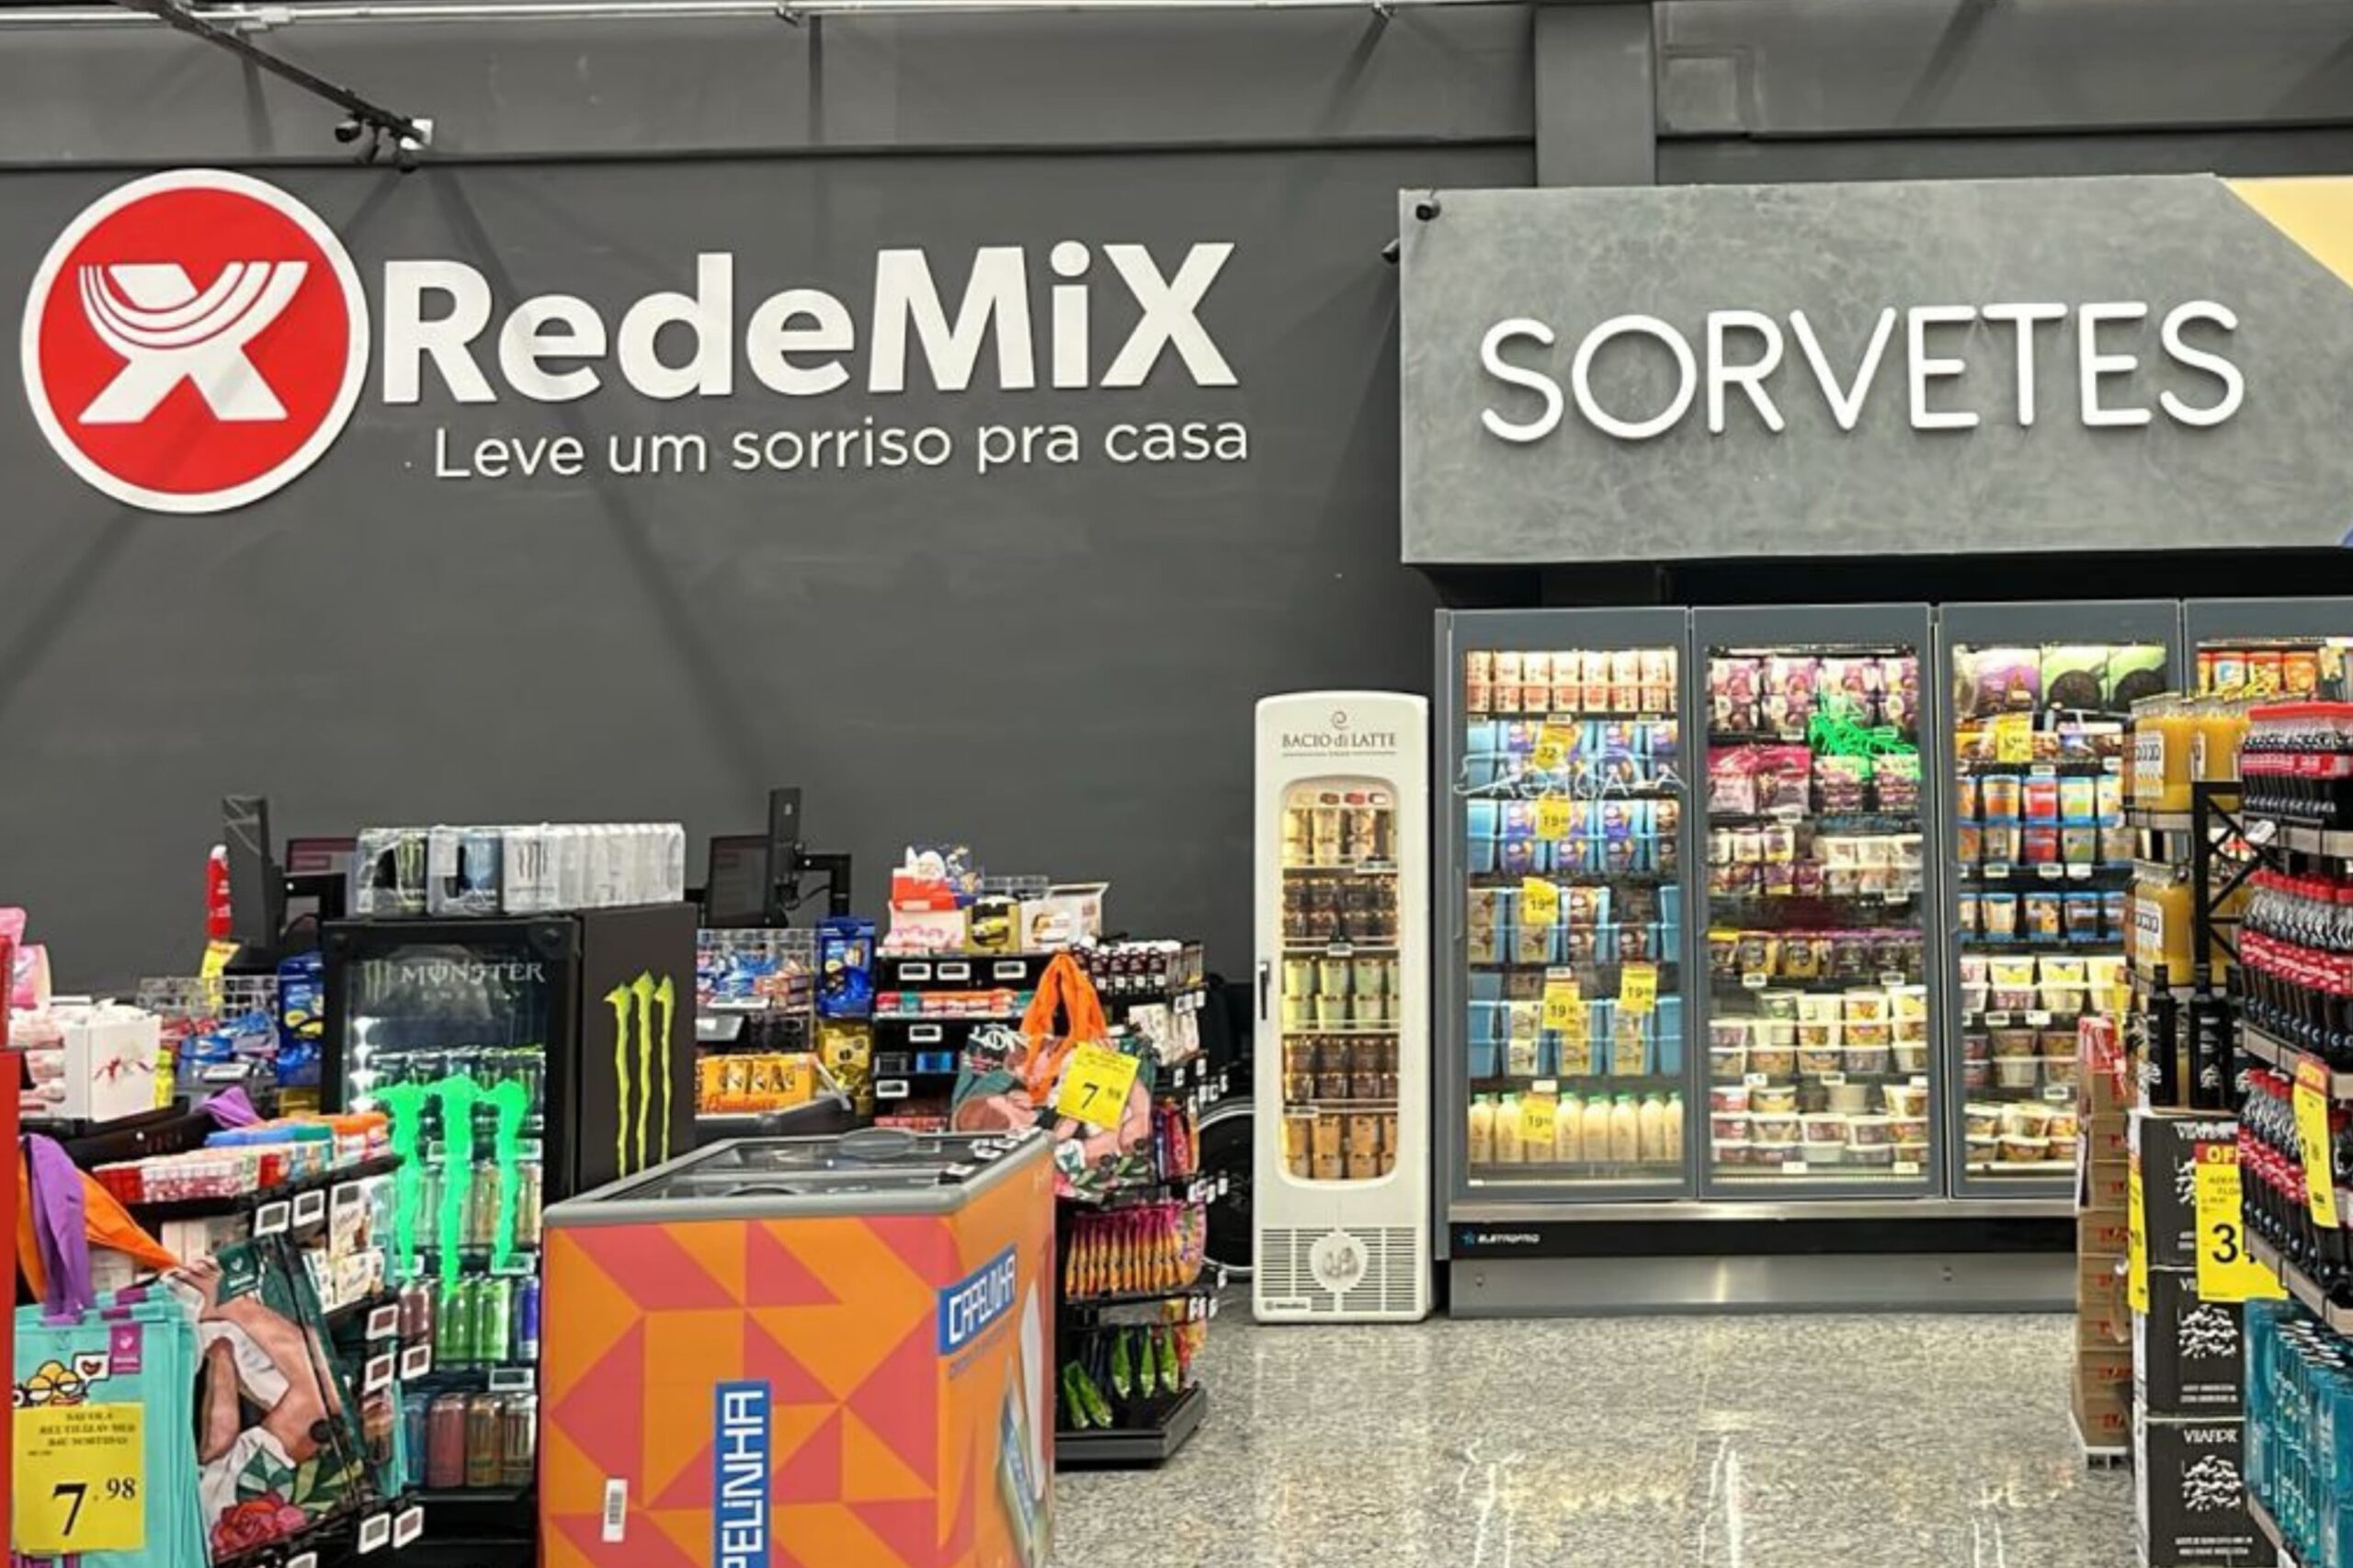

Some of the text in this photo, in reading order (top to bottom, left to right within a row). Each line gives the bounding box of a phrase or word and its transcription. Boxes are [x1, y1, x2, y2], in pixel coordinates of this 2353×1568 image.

[382, 240, 1239, 403] RedeMiX
[1480, 300, 2245, 442] SORVETES
[436, 416, 1247, 477] Leve um sorriso pra casa
[1281, 733, 1332, 748] BACIO
[1351, 732, 1396, 747] LATTE
[400, 959, 546, 988] MONSTER
